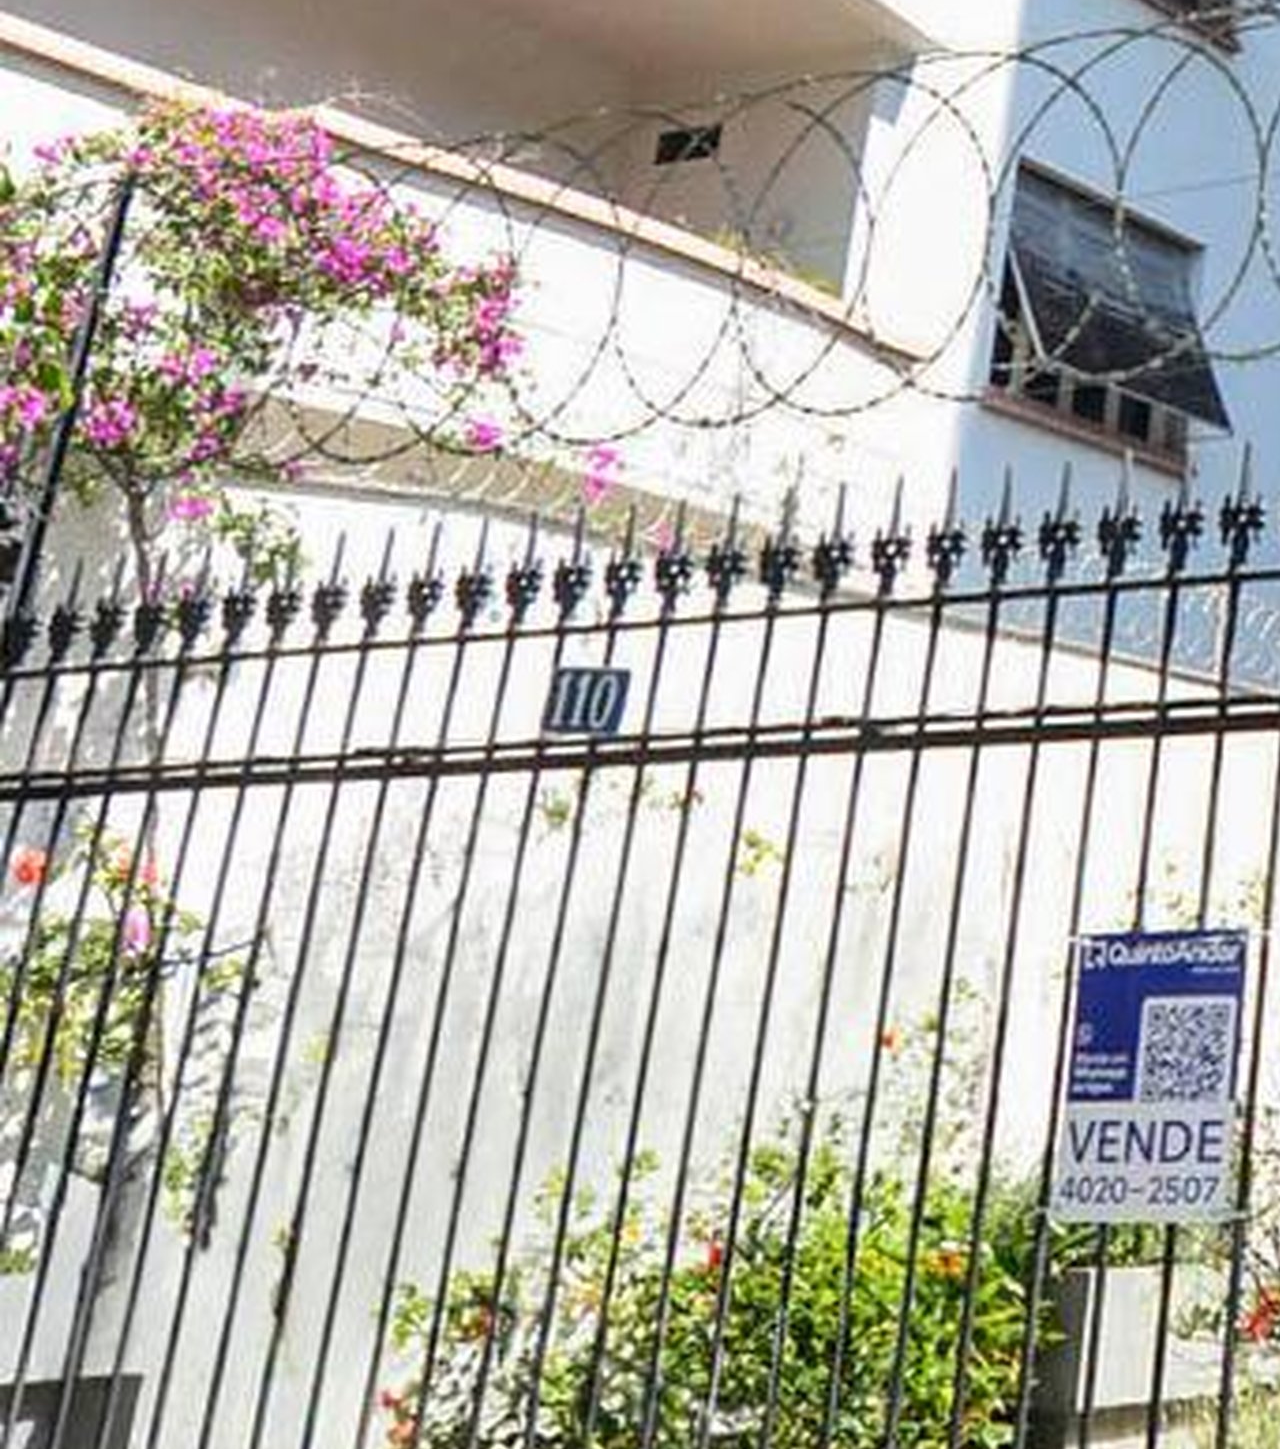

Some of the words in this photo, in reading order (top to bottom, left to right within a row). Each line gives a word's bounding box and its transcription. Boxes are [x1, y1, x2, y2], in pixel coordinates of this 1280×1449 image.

[550, 672, 619, 728] 110
[1069, 1119, 1225, 1164] VENDE
[1060, 1176, 1221, 1205] 4020-2507
